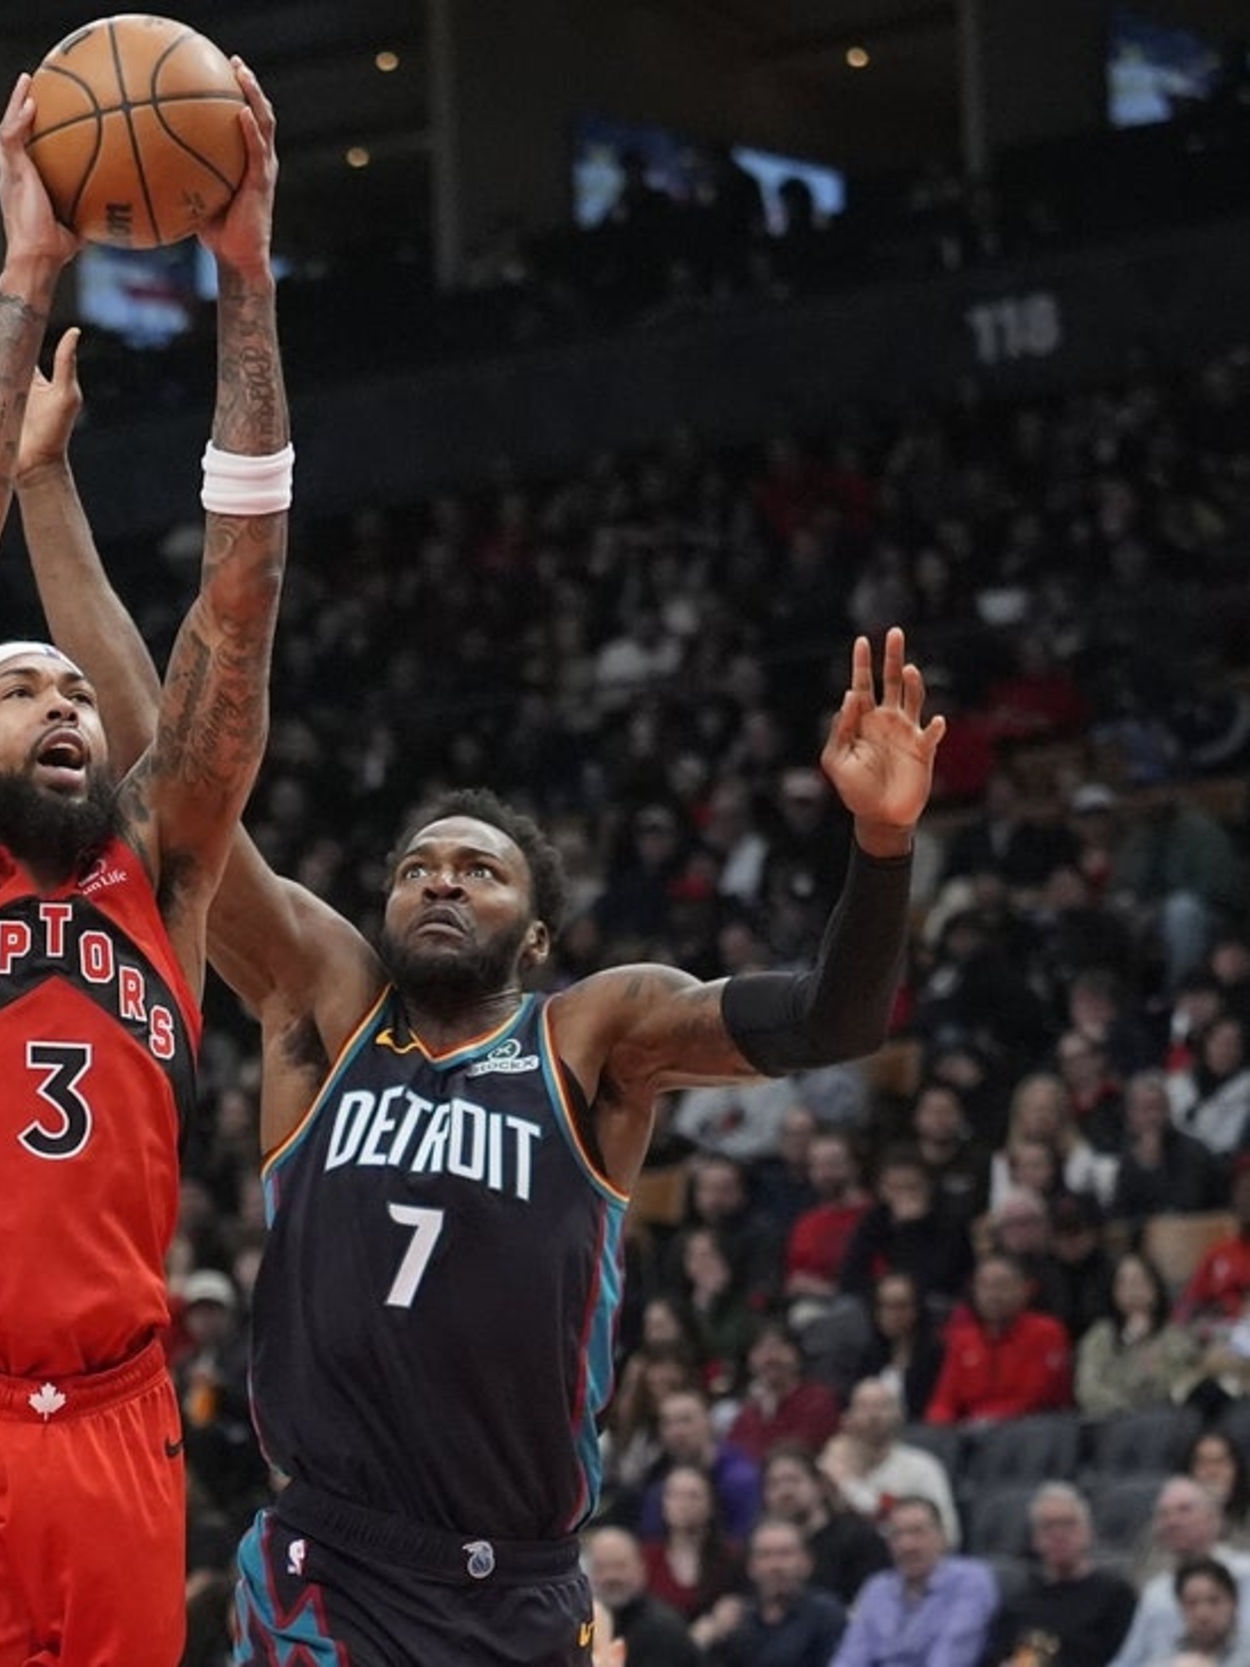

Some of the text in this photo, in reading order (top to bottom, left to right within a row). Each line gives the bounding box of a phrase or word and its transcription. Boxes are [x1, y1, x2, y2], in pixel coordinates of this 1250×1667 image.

[17, 1040, 94, 1160] 3
[324, 1084, 542, 1202] DETROIT
[384, 1201, 445, 1309] 7
